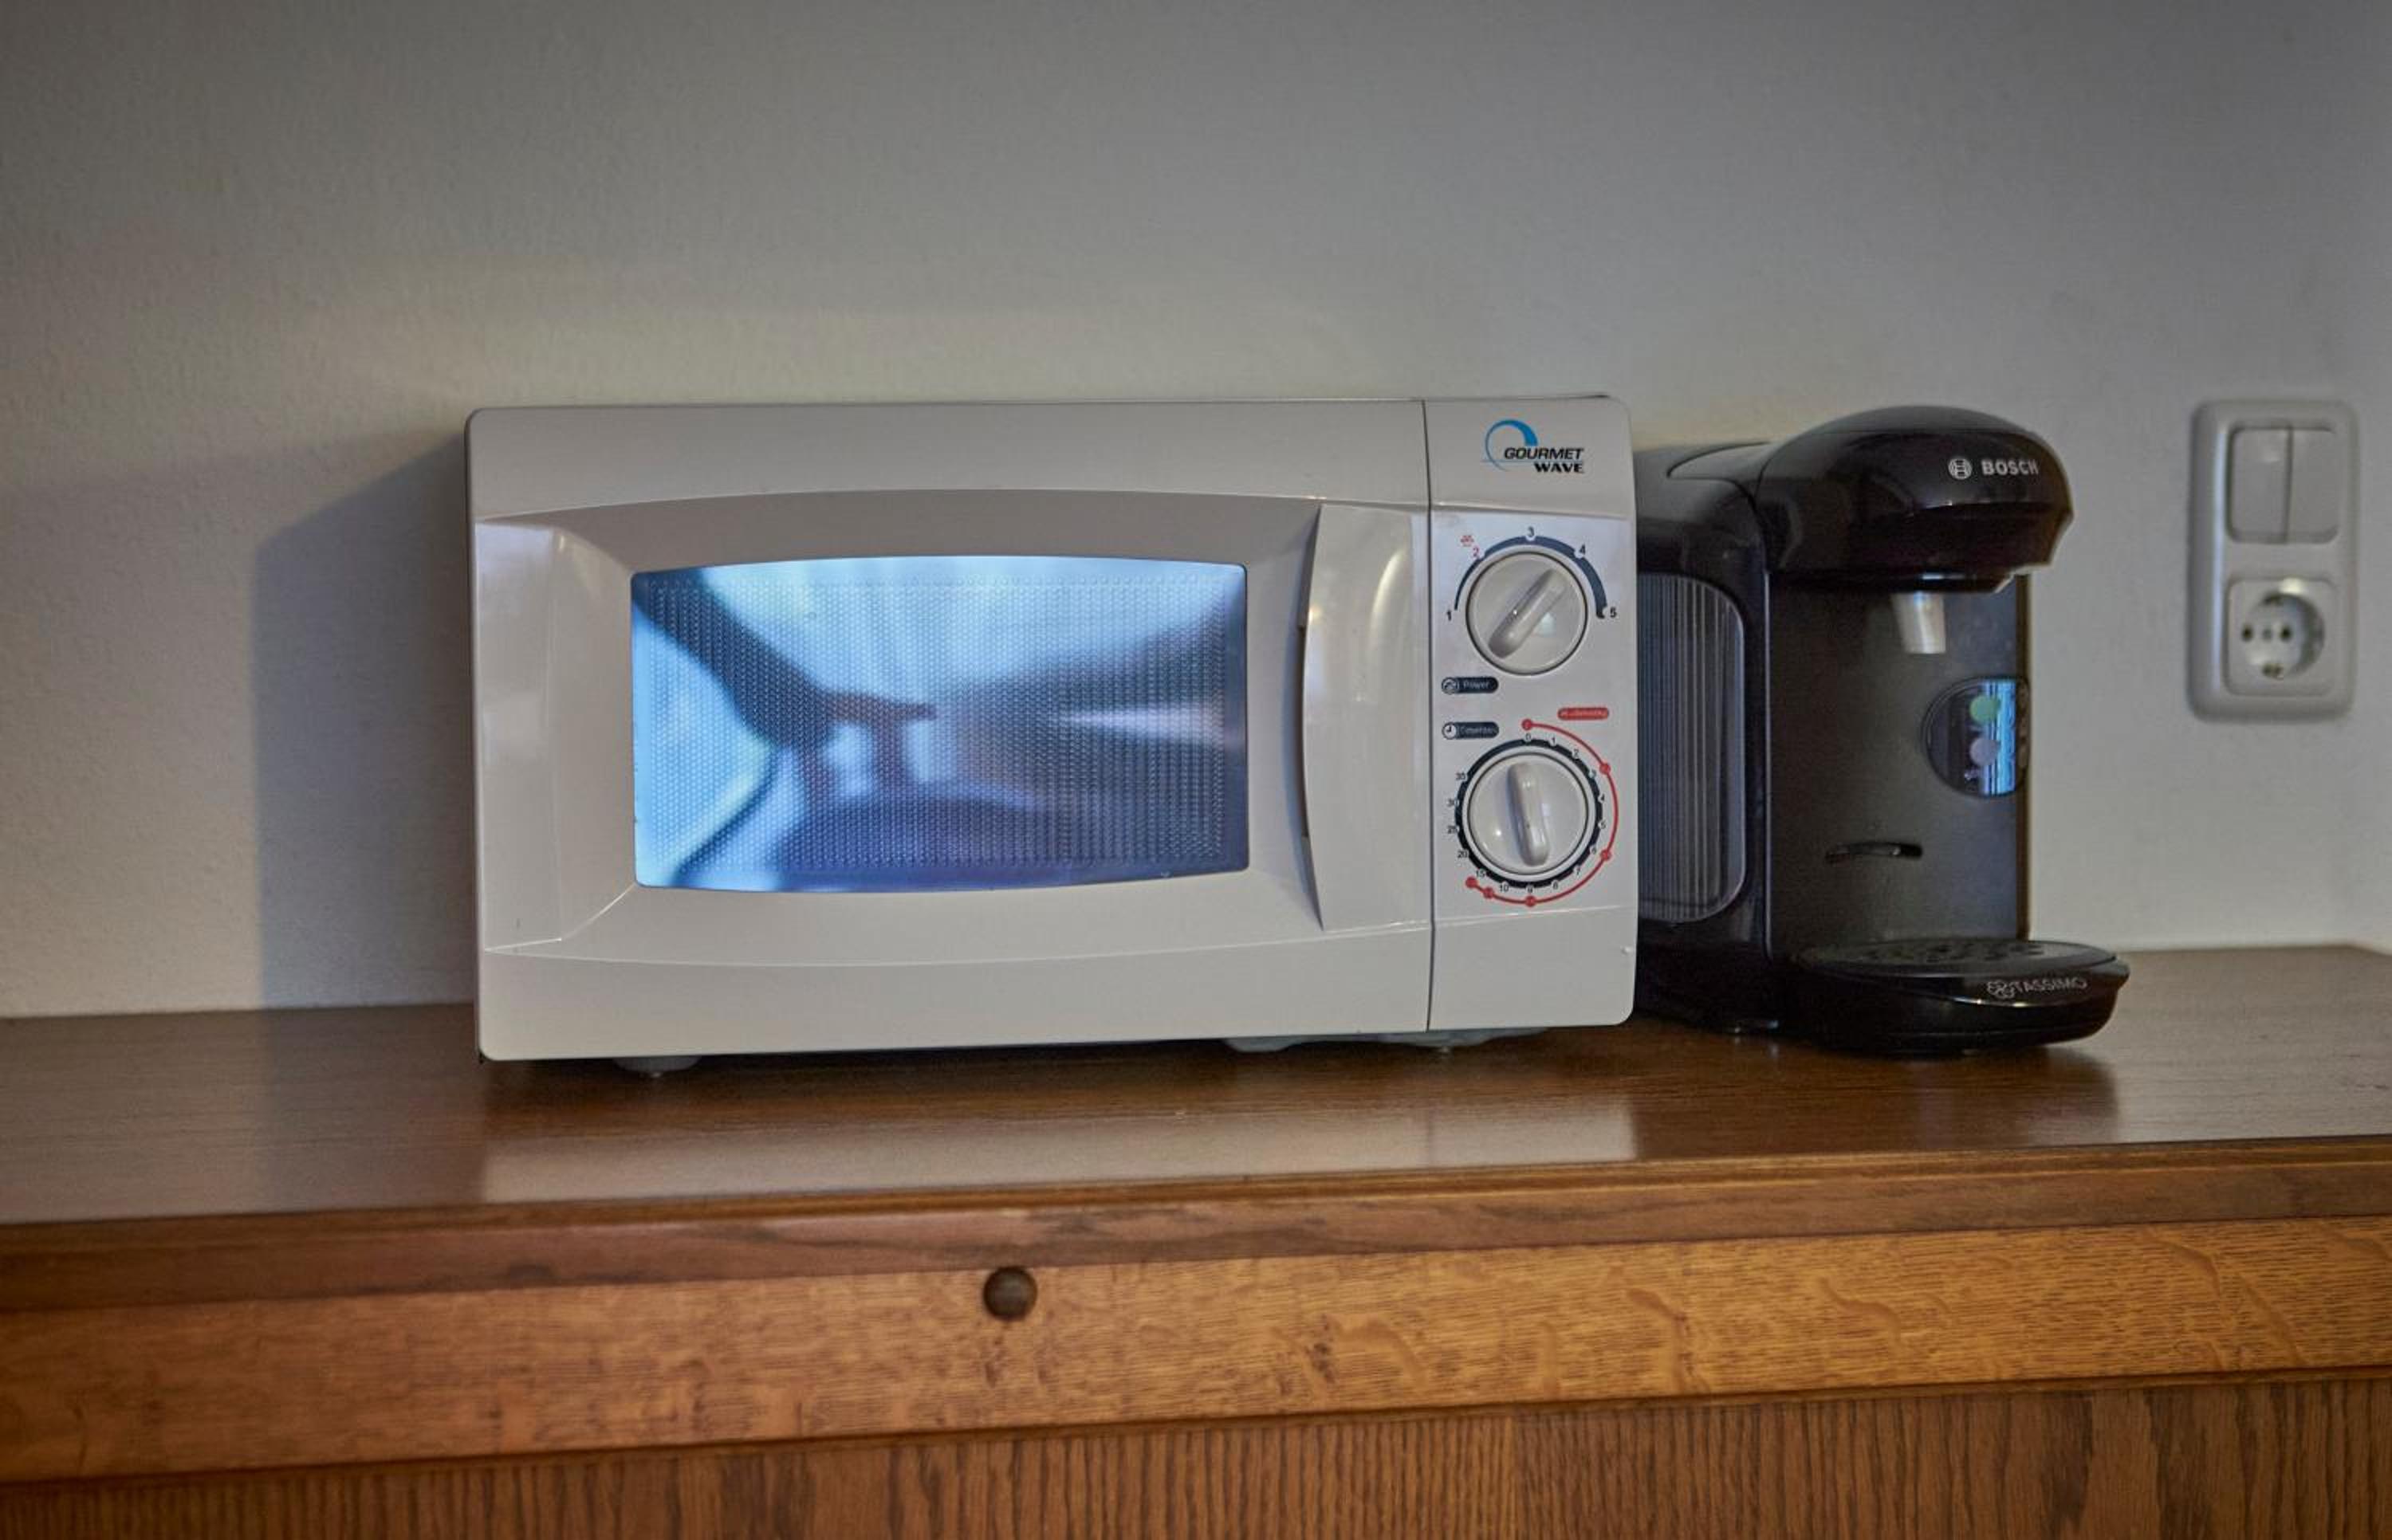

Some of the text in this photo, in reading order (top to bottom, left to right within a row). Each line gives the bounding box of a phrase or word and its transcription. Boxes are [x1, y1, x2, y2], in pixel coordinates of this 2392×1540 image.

[1504, 447, 1584, 460] GOURMET
[1533, 462, 1585, 474] WAVE
[1981, 459, 2039, 476] BOSCH
[1527, 526, 1535, 537] 3
[1472, 546, 1480, 558] 2
[1579, 544, 1587, 555] 4
[1446, 609, 1453, 622] 1
[1609, 607, 1618, 619] 5
